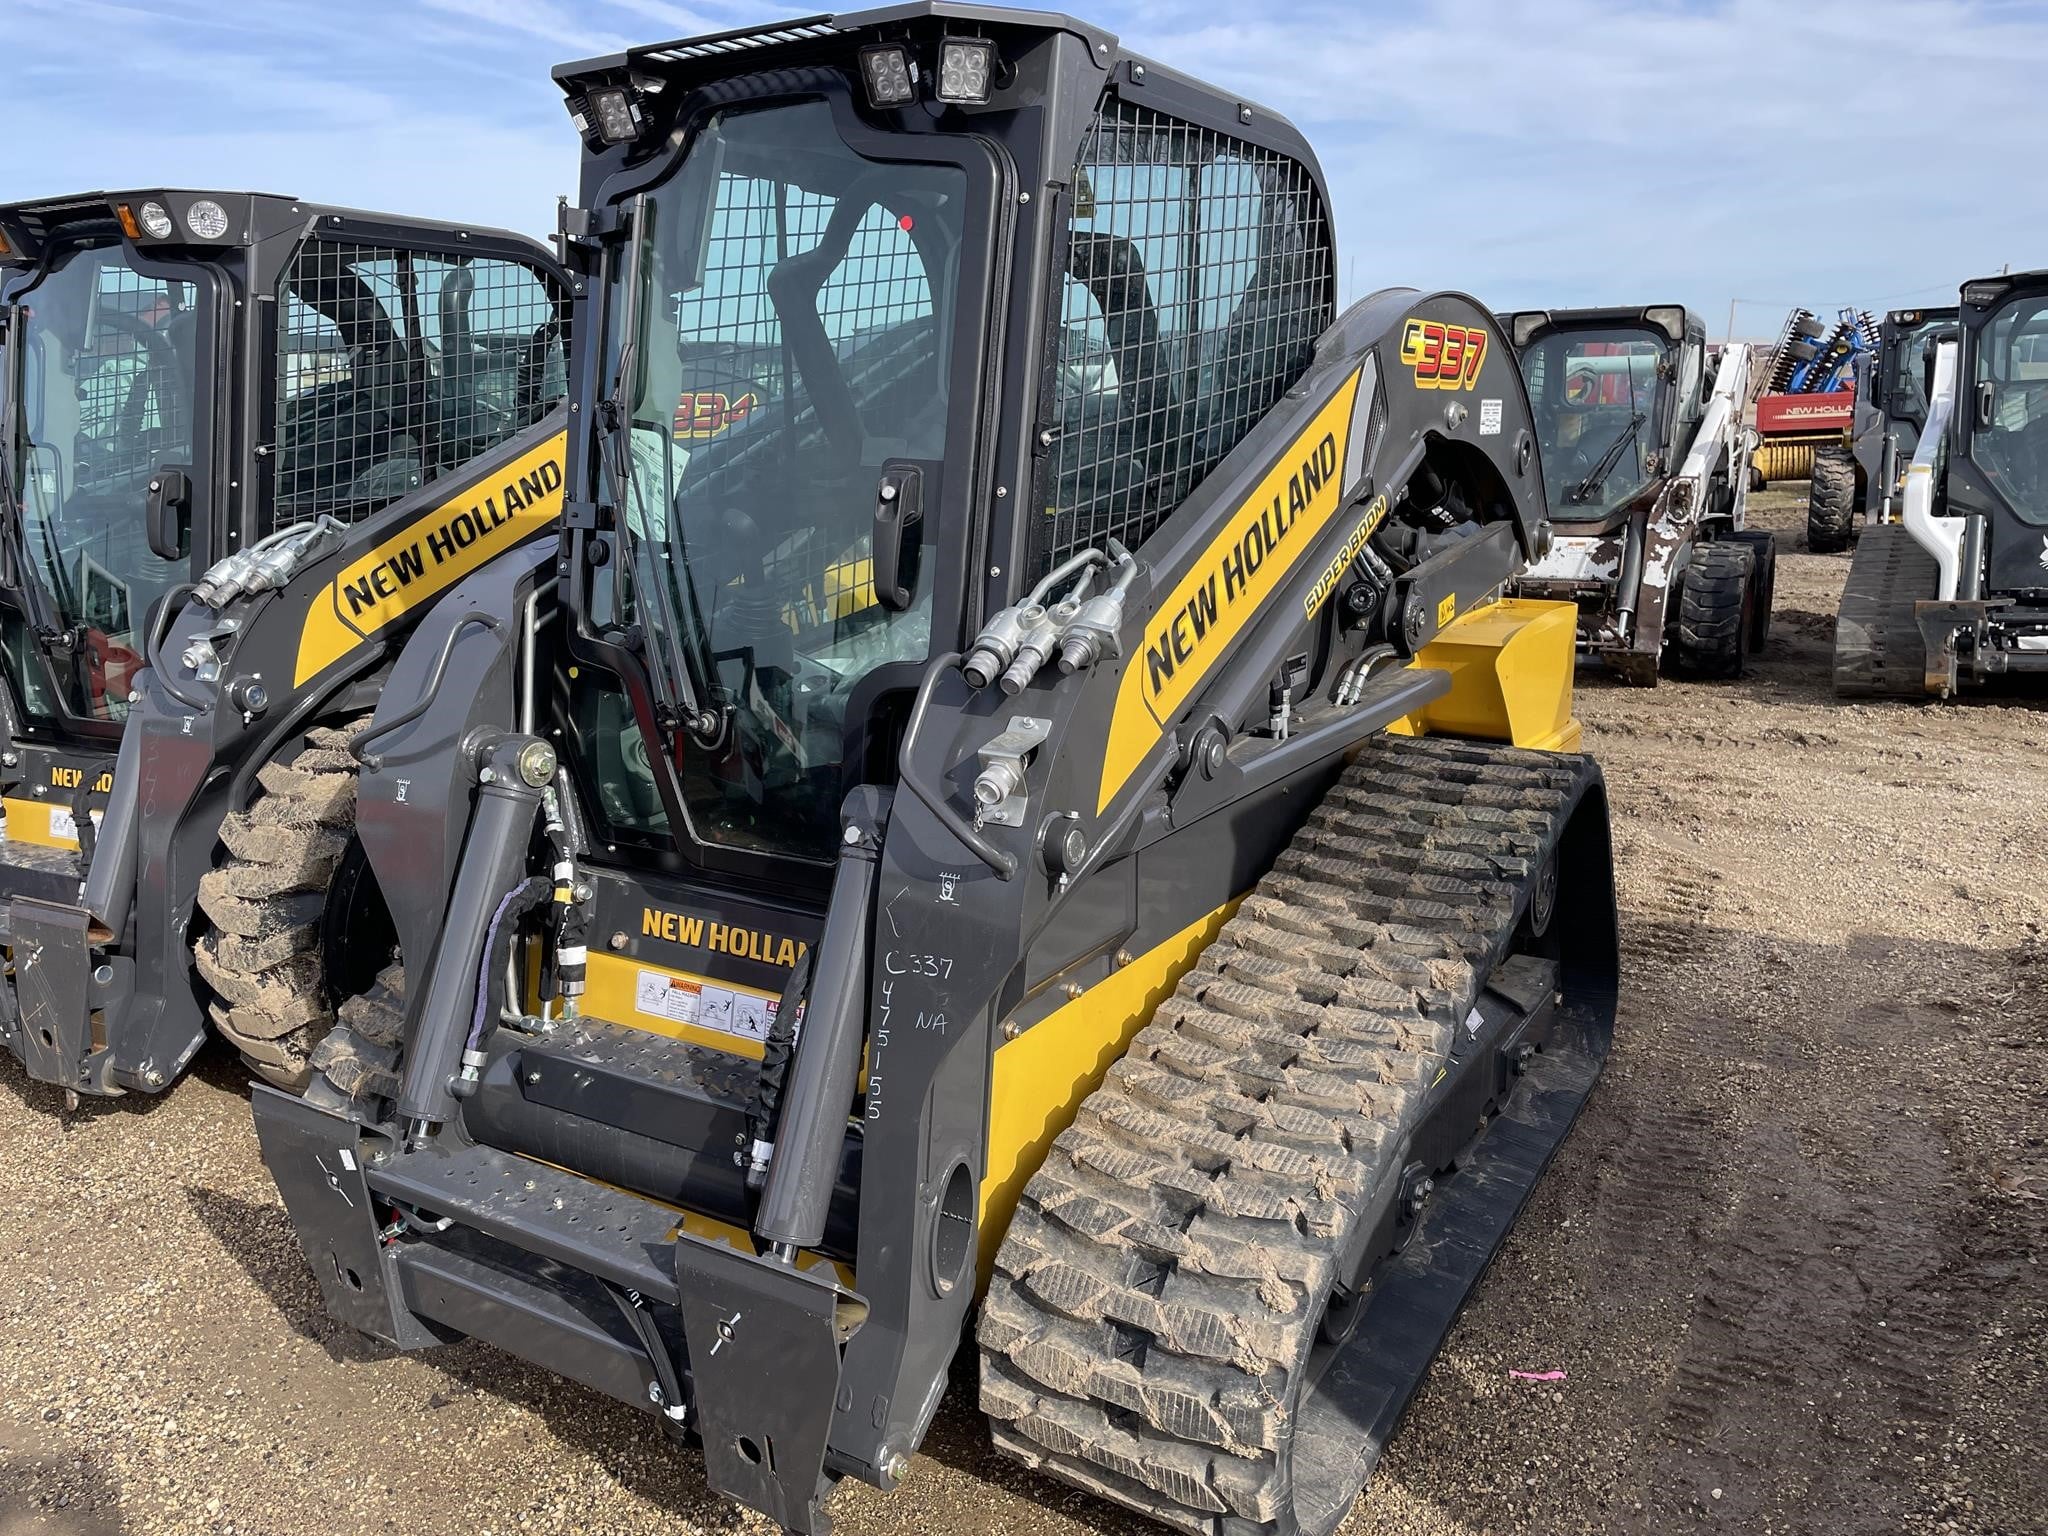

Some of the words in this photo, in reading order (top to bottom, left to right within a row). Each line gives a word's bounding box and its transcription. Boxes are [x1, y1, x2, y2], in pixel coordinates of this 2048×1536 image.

[1401, 319, 1487, 391] C337
[1786, 406, 1812, 415] NEW
[343, 541, 426, 617] NEW
[426, 458, 562, 566] HOLLAND
[1146, 571, 1218, 696] NEW
[1222, 431, 1337, 606] HOLLAND
[1304, 545, 1352, 620] SUPER
[1348, 494, 1387, 559] BOOM
[641, 907, 704, 947] NEW
[915, 1011, 949, 1035] NA
